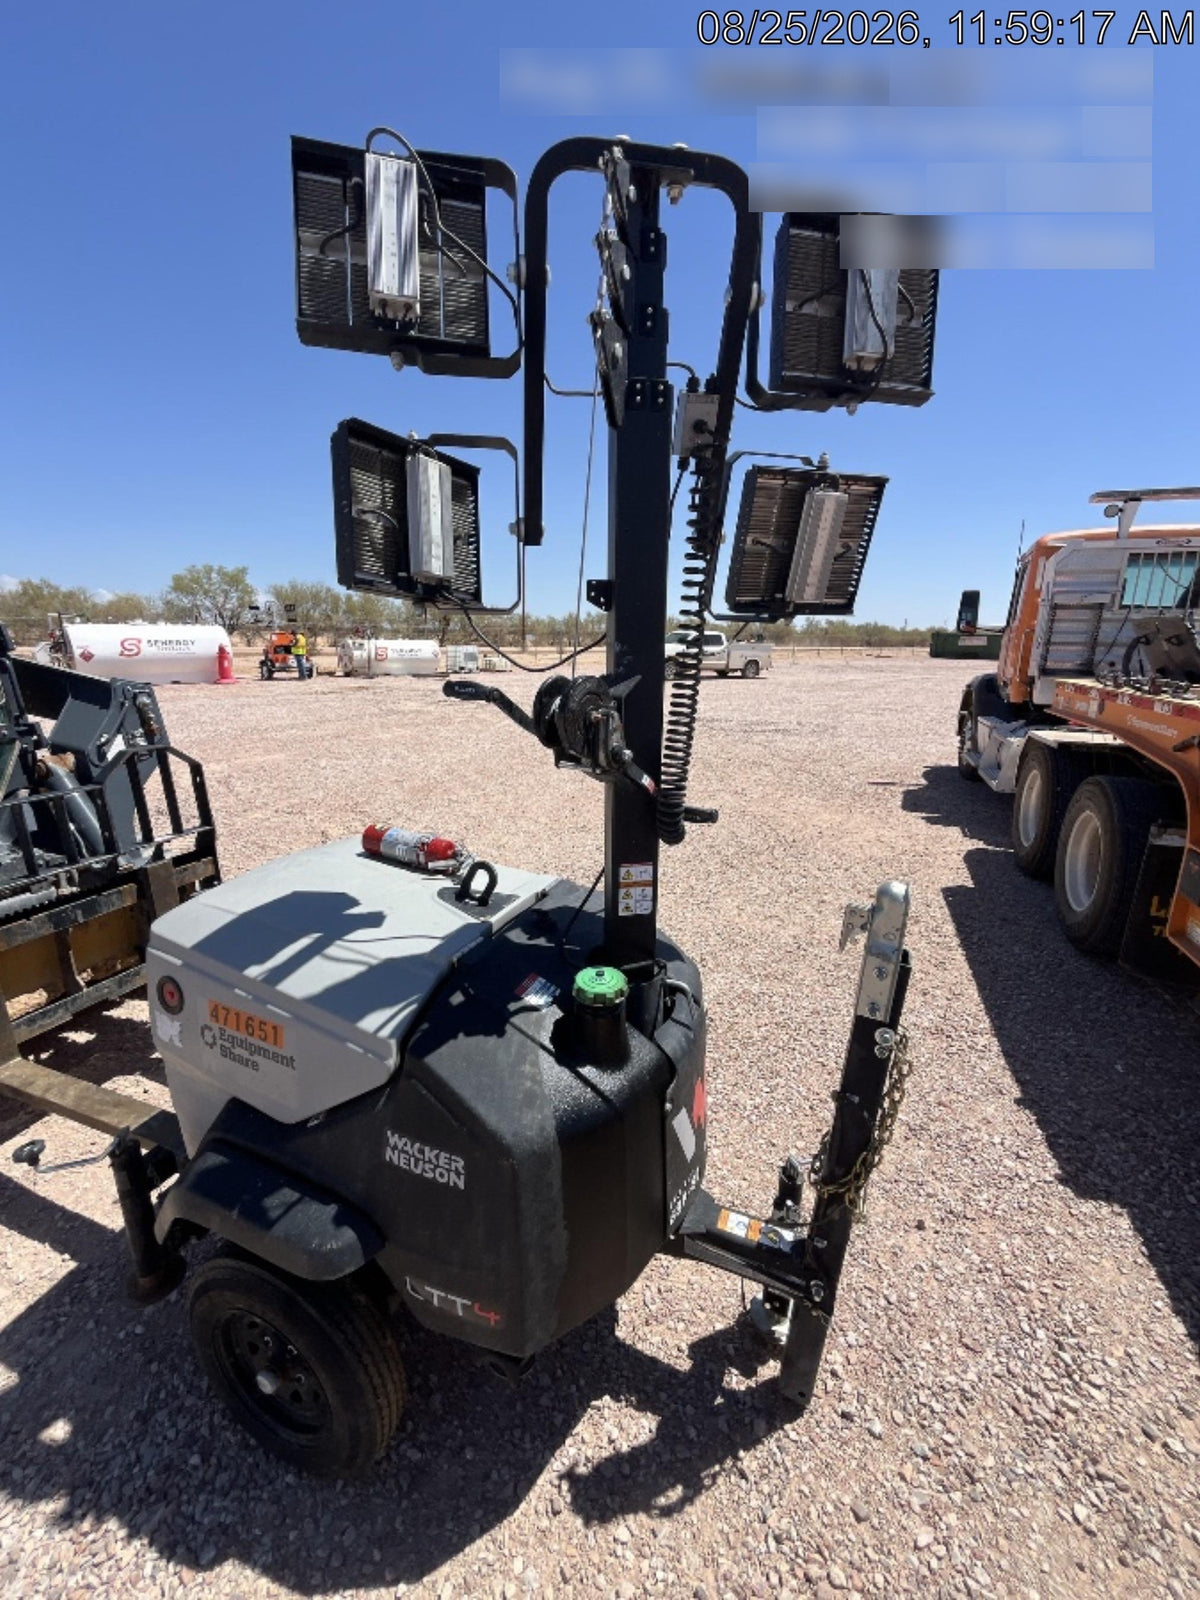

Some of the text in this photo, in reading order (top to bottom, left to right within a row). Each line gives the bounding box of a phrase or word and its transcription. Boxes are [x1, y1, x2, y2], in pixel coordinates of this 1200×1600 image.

[209, 1003, 279, 1046] 471651
[218, 1027, 296, 1071] Equipment
[219, 1043, 260, 1072] Share
[385, 1146, 465, 1190] NEUSON
[386, 1129, 465, 1174] WACKER
